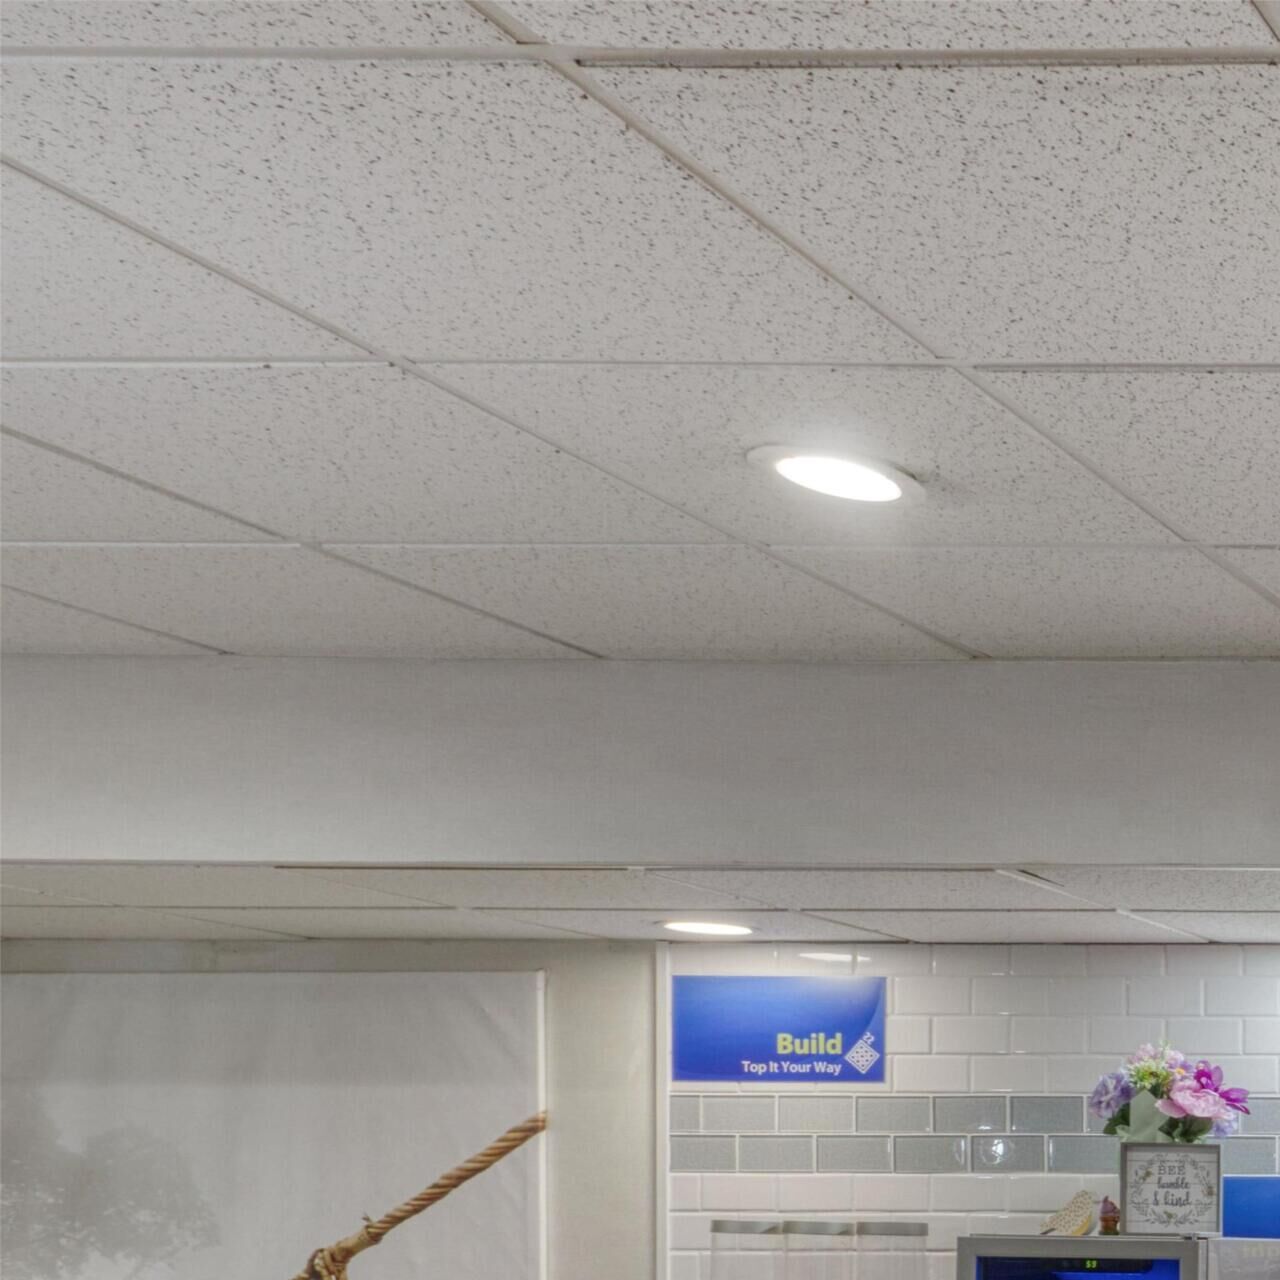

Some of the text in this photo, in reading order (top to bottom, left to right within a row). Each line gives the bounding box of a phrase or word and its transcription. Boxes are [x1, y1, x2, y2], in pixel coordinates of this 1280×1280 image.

[776, 1032, 842, 1055] Build
[741, 1061, 842, 1076] Top It Your Way
[1157, 1165, 1186, 1176] BEE
[1164, 1190, 1192, 1207] kind
